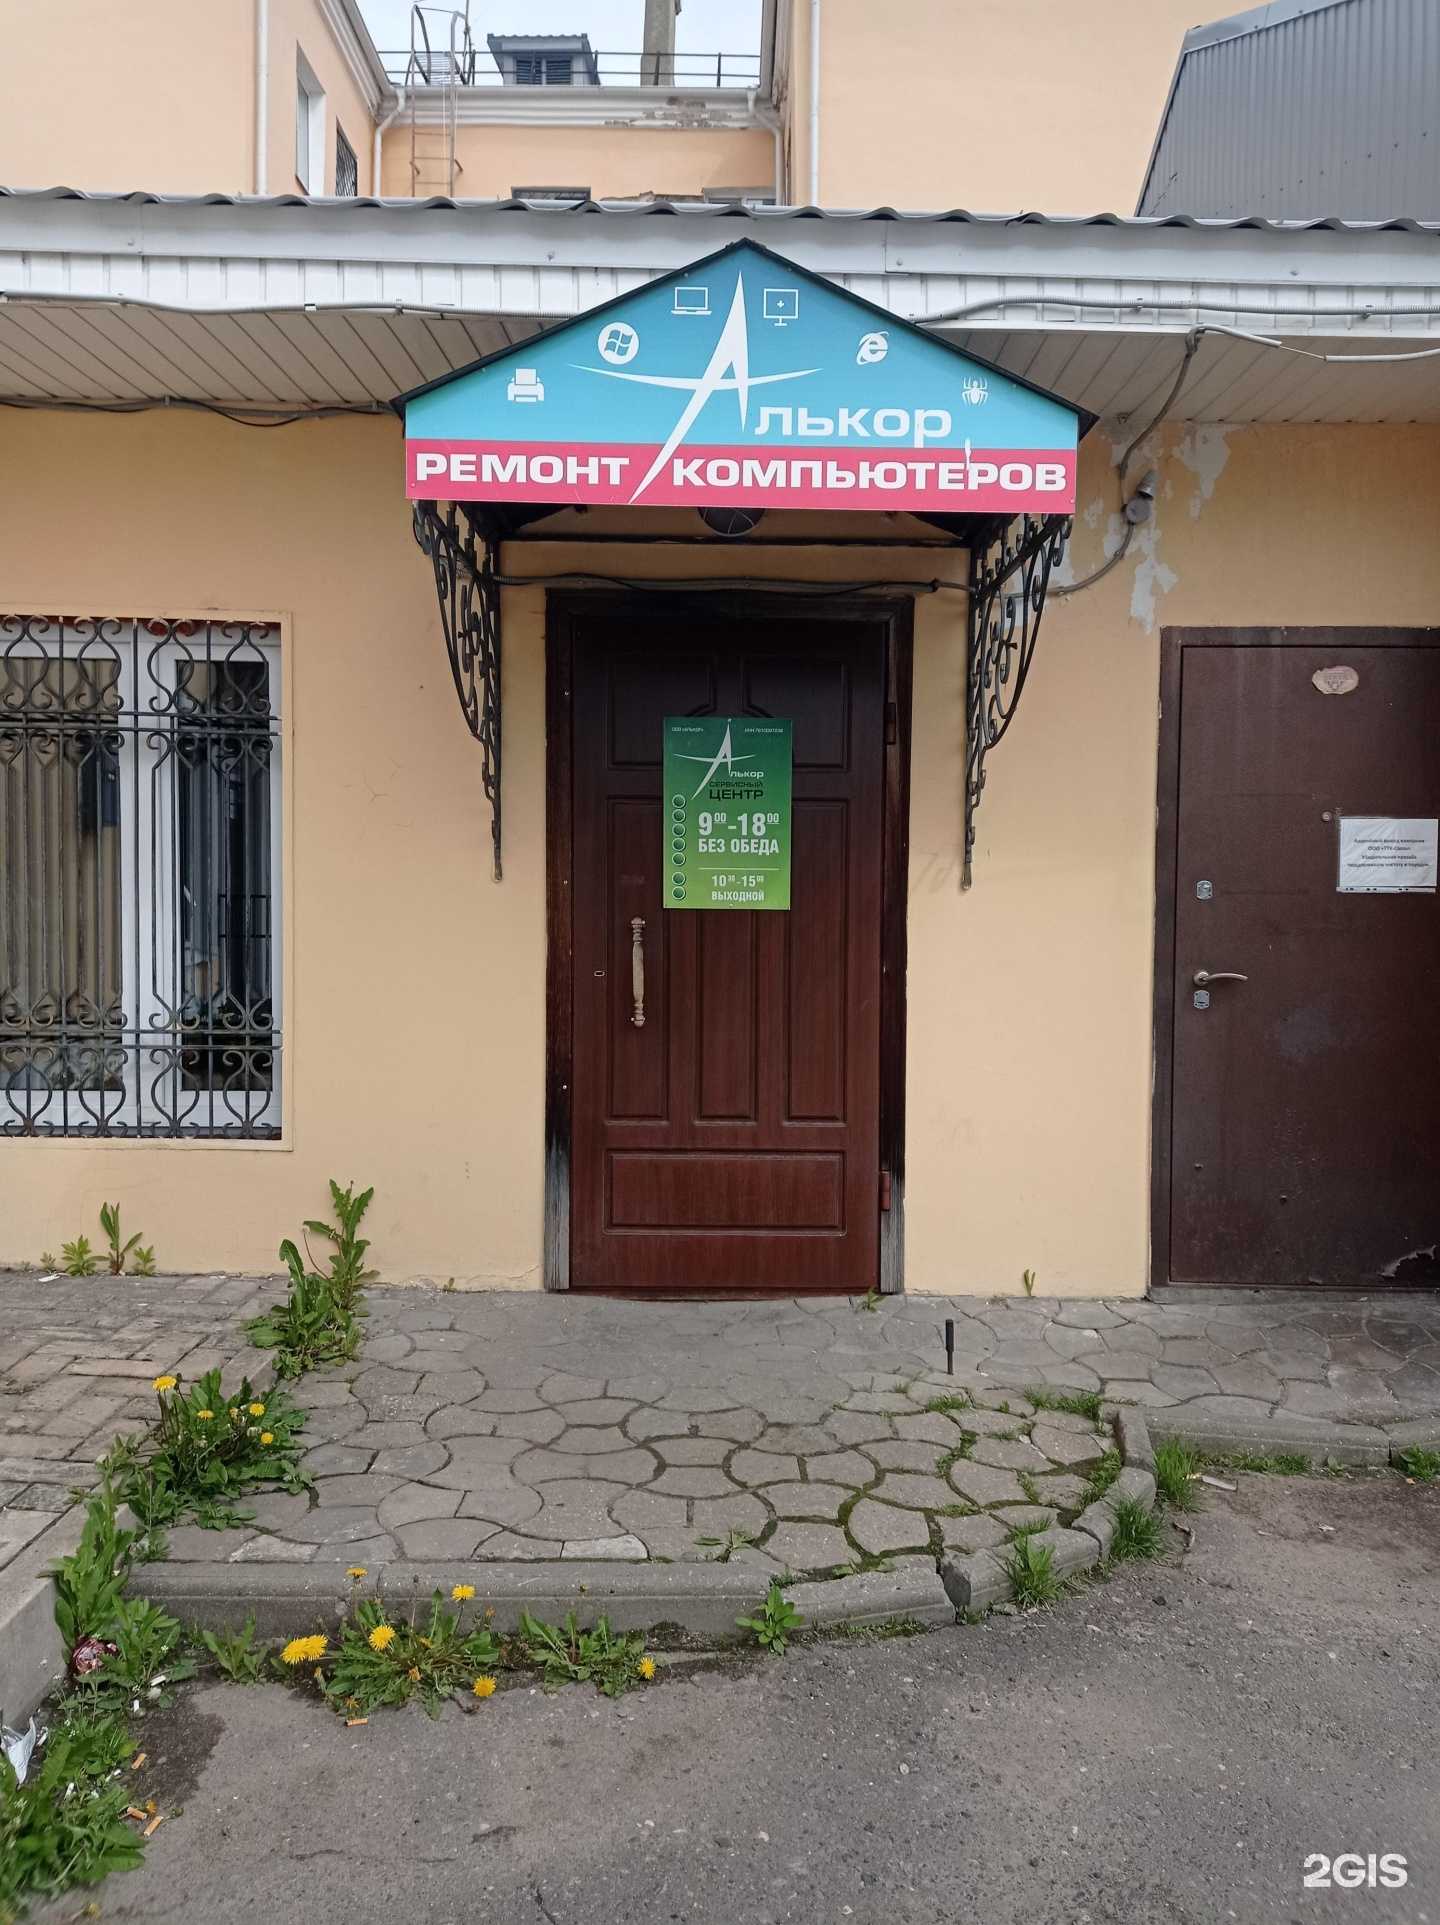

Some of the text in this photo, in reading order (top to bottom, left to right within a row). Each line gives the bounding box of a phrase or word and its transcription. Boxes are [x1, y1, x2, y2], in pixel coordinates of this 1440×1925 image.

[416, 452, 1067, 493] РЕМОНТ КОМПЬЮТЕРОВ
[709, 780, 764, 788] СЕРВИСНЫЙ
[709, 789, 764, 802] ЦЕНТР
[698, 838, 780, 856] БЕЗ ОБЕДА
[711, 889, 765, 903] ВЫХОДНОЙ
